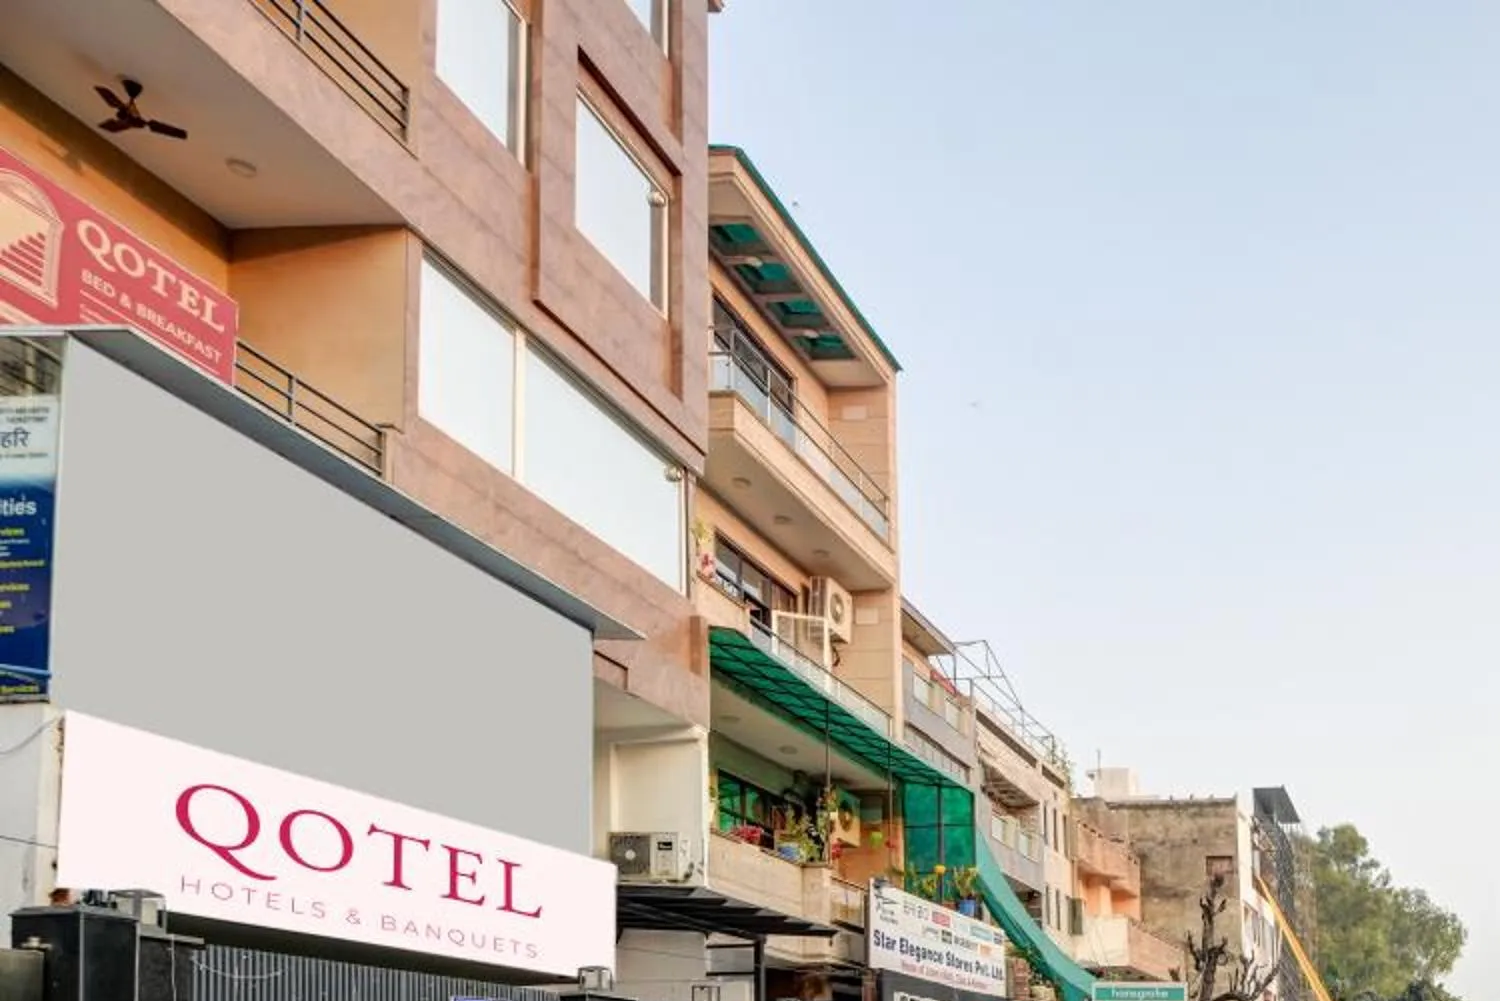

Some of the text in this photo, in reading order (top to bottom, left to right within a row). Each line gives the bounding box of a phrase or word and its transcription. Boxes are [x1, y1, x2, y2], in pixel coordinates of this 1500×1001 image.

[77, 219, 225, 333] QOTEL
[81, 269, 222, 364] BED & BREAKFAST
[0, 497, 37, 516] ties
[175, 783, 543, 919] QOTEL
[180, 874, 540, 960] HOTELS & BANQUETS
[873, 929, 897, 951] Star
[900, 936, 944, 965] Elegance
[945, 950, 973, 973] Stores
